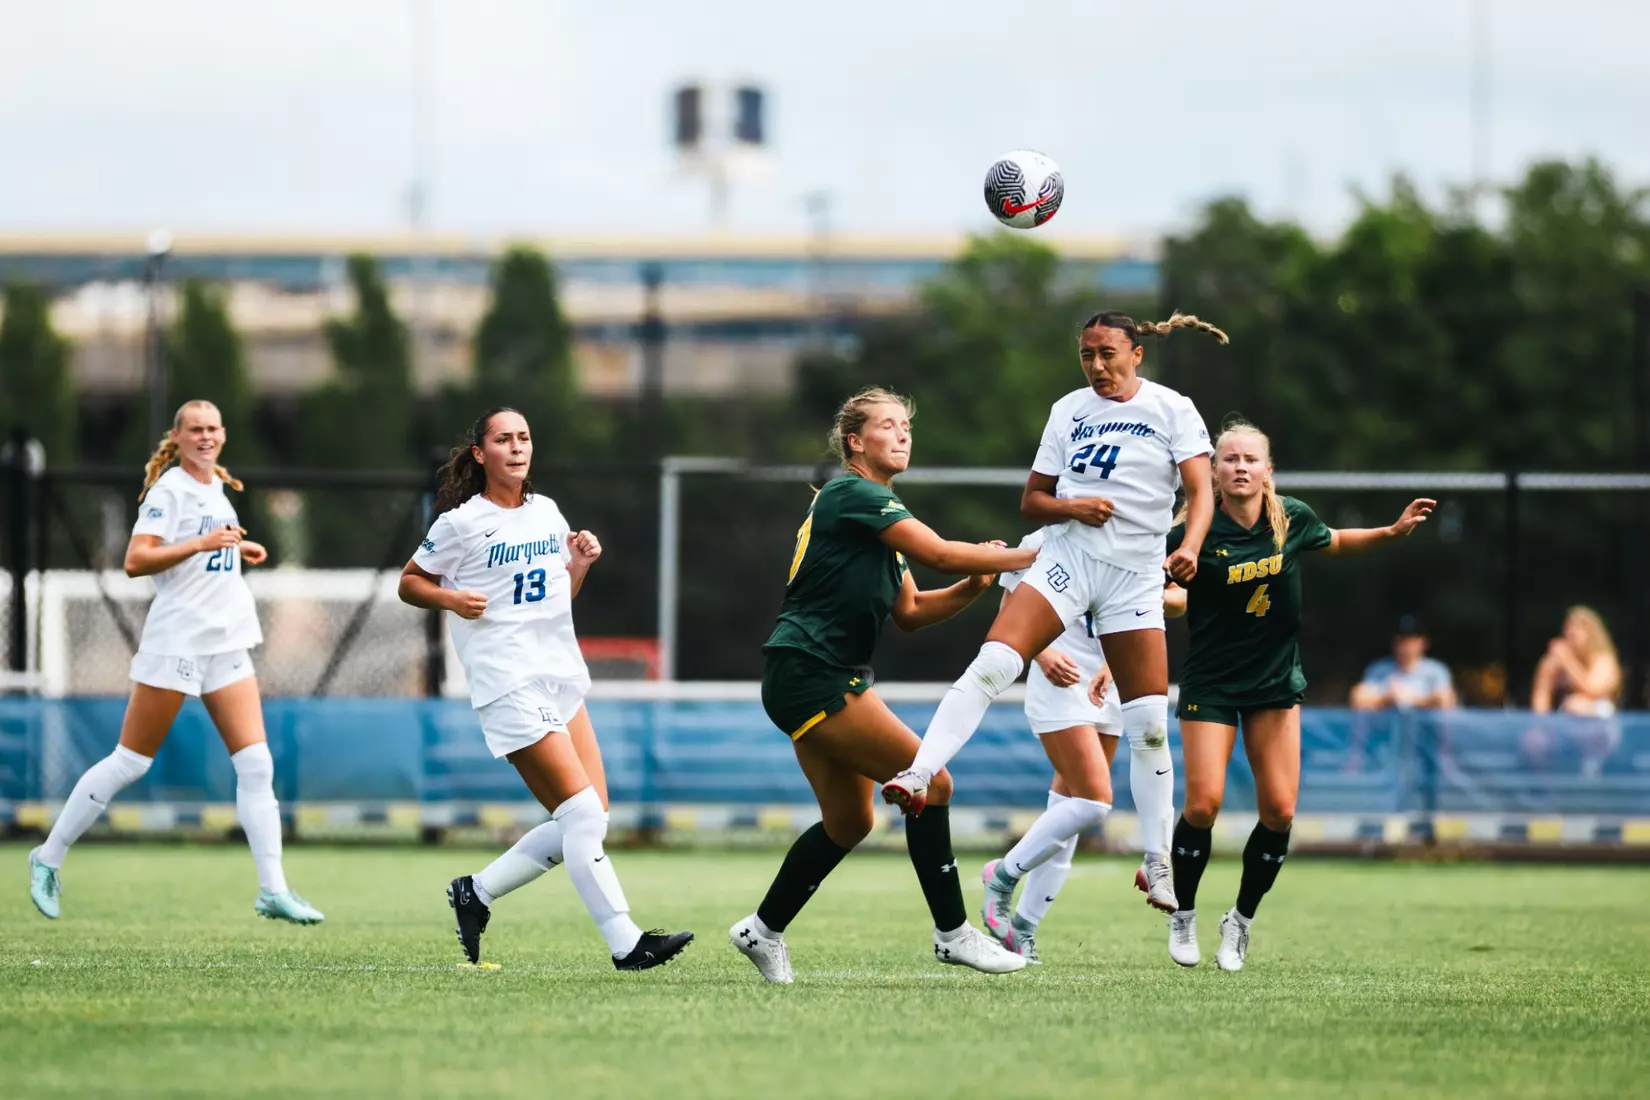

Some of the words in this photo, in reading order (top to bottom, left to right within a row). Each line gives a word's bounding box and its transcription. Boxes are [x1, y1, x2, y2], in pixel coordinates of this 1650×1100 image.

[1070, 444, 1121, 479] 24
[206, 549, 234, 571] 20
[1227, 553, 1284, 585] NDSU
[513, 568, 546, 605] 13
[1246, 584, 1271, 617] 4
